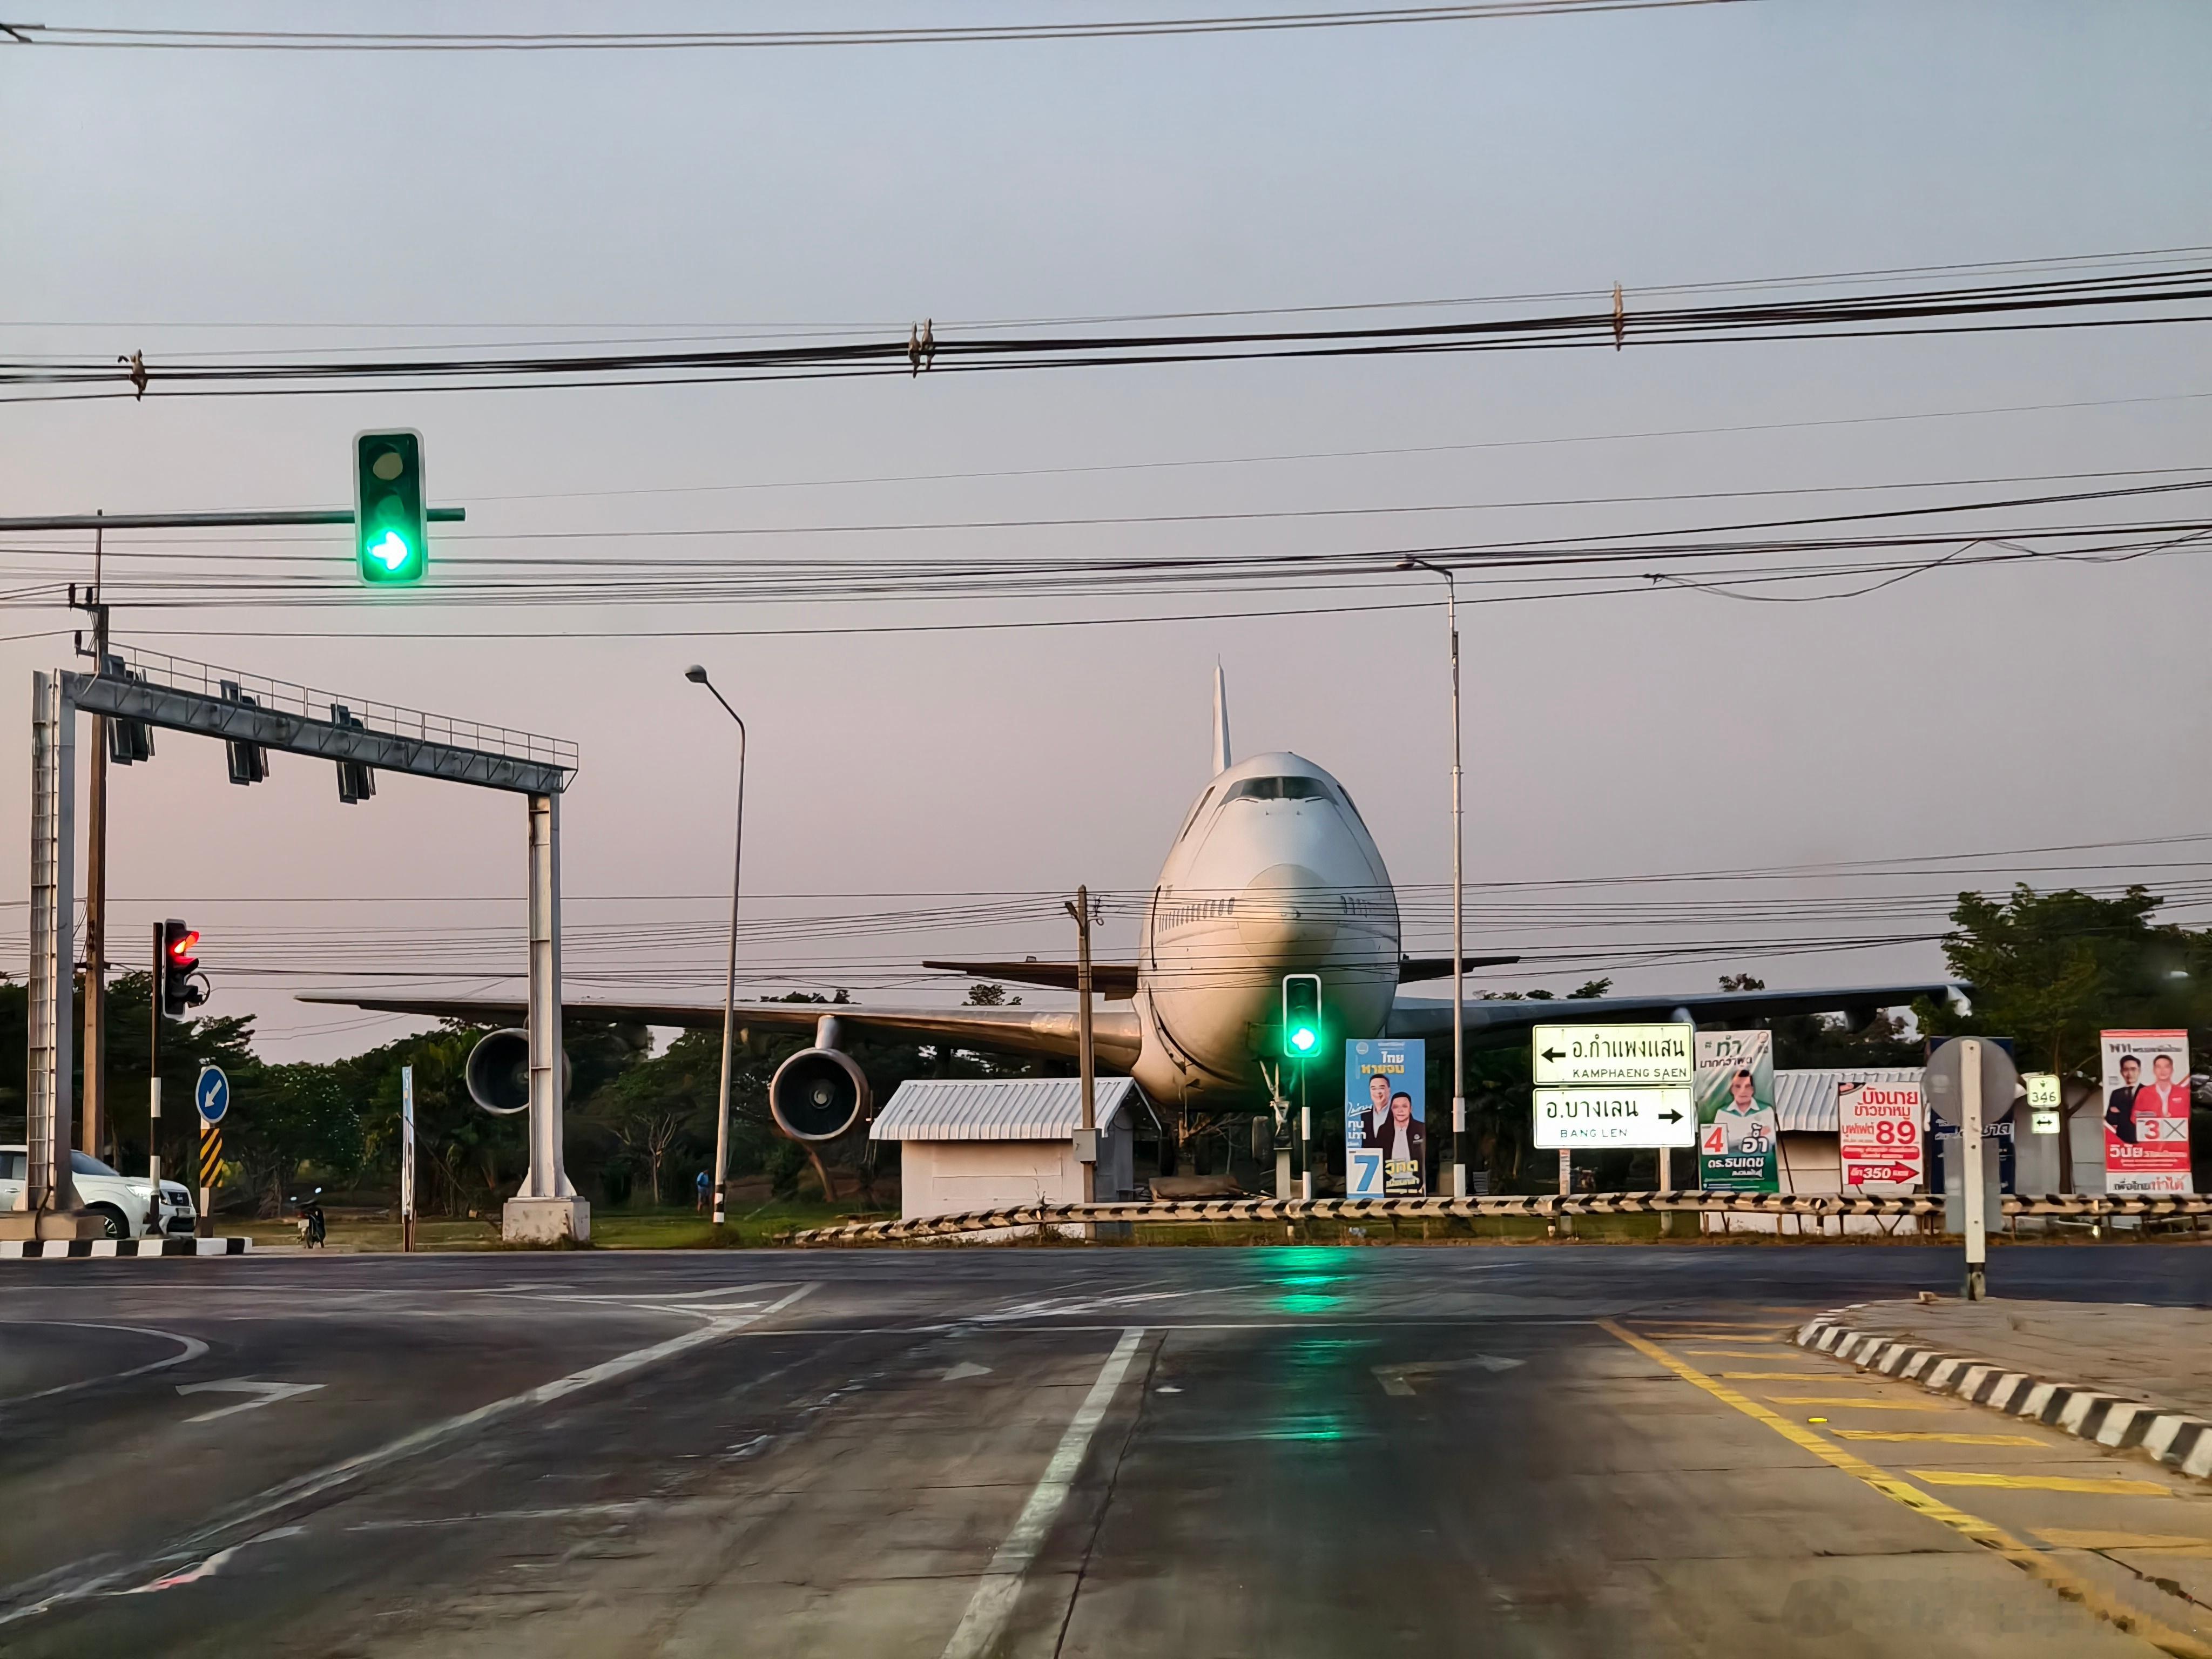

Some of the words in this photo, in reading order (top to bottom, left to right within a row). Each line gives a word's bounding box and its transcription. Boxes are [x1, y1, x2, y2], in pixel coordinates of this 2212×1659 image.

[1573, 1034, 1685, 1057] อ.กำแพงแสน
[1573, 1069, 1649, 1078] KAMPHAENG
[1654, 1068, 1687, 1077] SAEN
[2032, 1091, 2056, 1102] 346
[1546, 1101, 1638, 1118] อ.บางเลน
[1854, 1102, 1911, 1120] ข้าวขาหมู
[1561, 1129, 1596, 1138] BANG
[1602, 1129, 1627, 1137] LEN
[1876, 1121, 1916, 1144] 89
[2144, 1120, 2160, 1139] 3
[1704, 1127, 1723, 1152] 4
[1354, 1155, 1379, 1192] 7
[1863, 1168, 1891, 1179] 350
